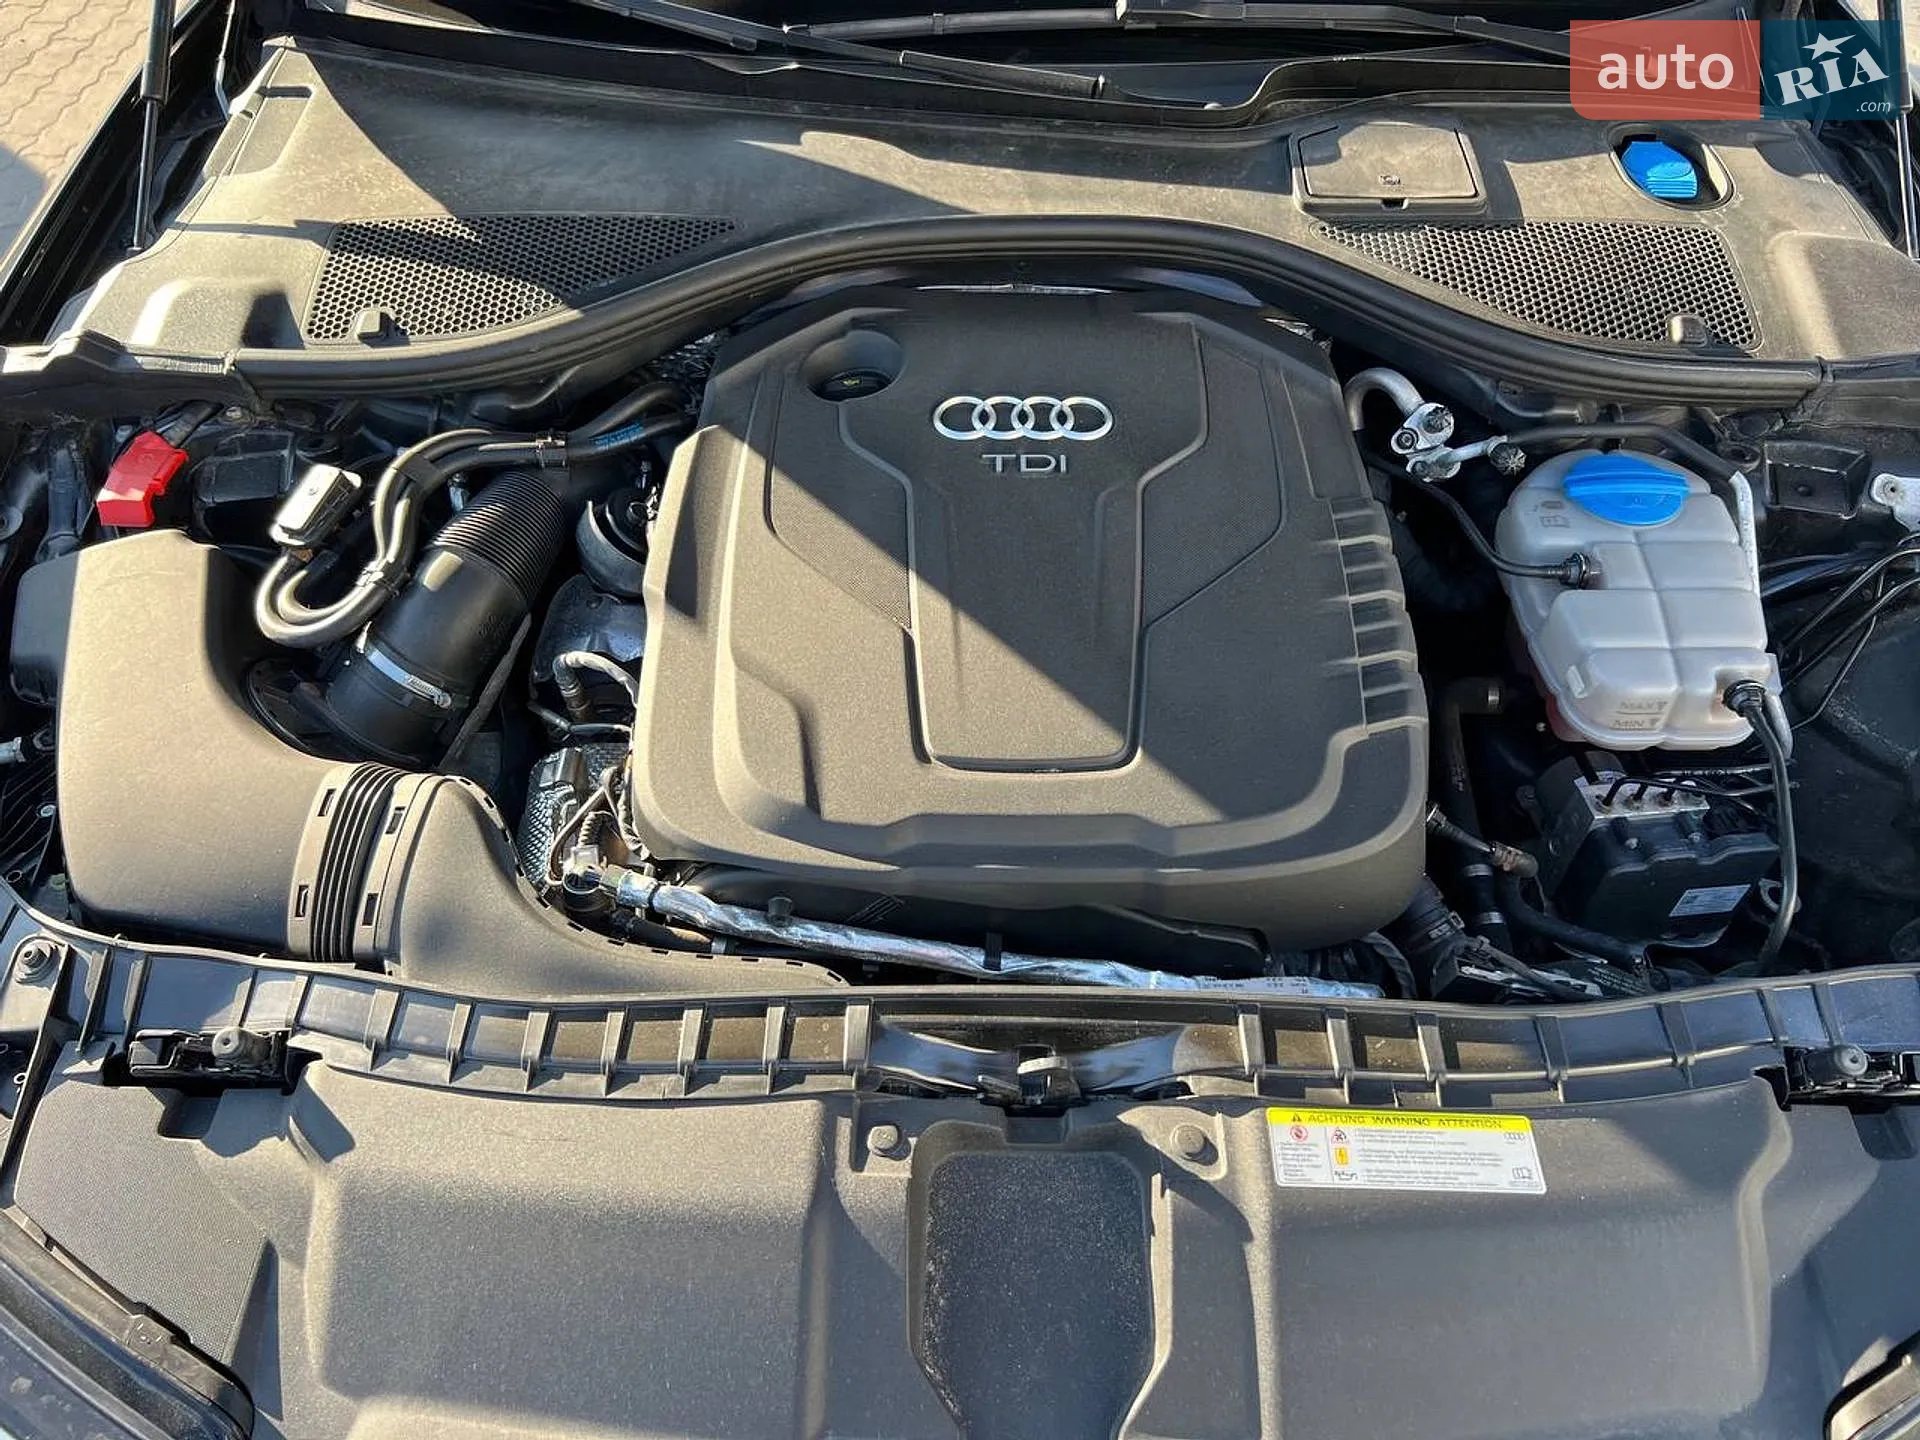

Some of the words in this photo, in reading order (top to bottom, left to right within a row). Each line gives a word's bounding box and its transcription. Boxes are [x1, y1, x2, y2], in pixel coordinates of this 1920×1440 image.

[981, 454, 1067, 473] TDI
[1307, 1115, 1366, 1125] ACHTUNG
[1371, 1117, 1430, 1127] WARNING
[1438, 1118, 1502, 1129] ATTENTION
